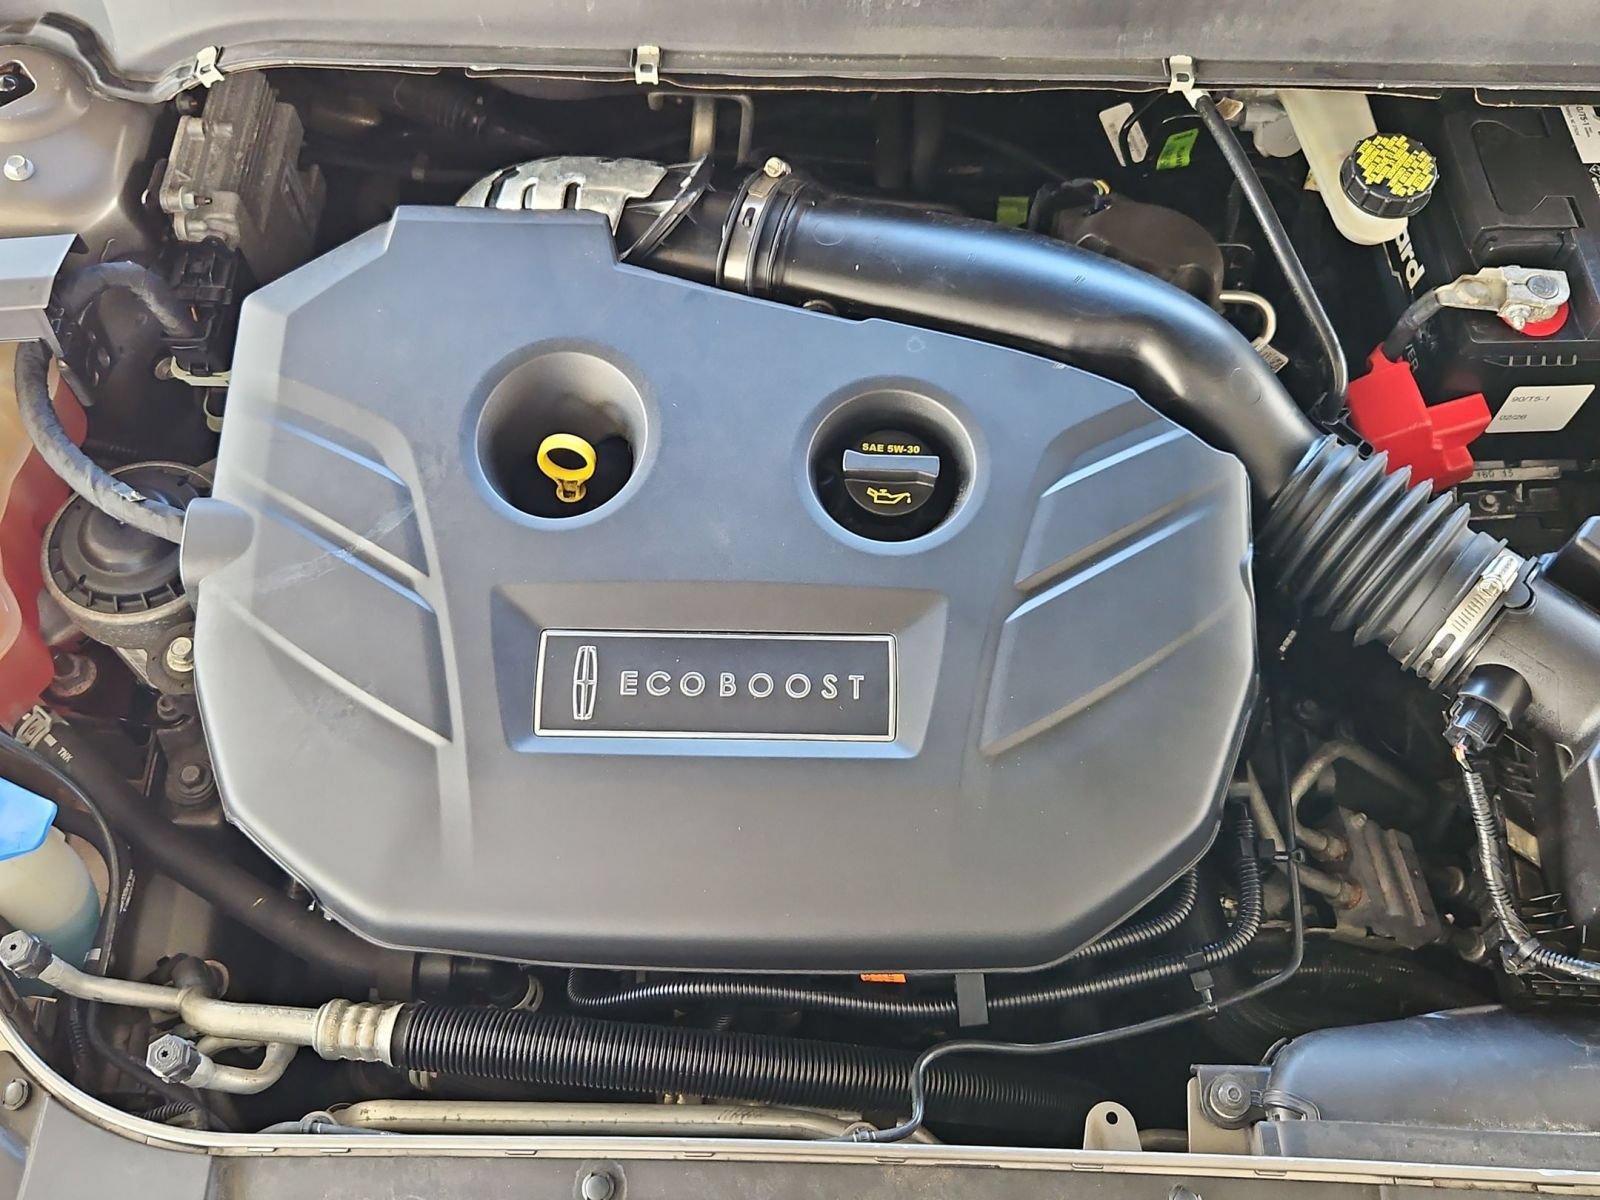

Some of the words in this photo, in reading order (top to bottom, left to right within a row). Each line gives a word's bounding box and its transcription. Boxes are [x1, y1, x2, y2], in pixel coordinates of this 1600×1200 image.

[862, 442, 885, 453] SAE
[887, 444, 921, 454] 5W-30
[619, 670, 866, 700] ECOBOOST
